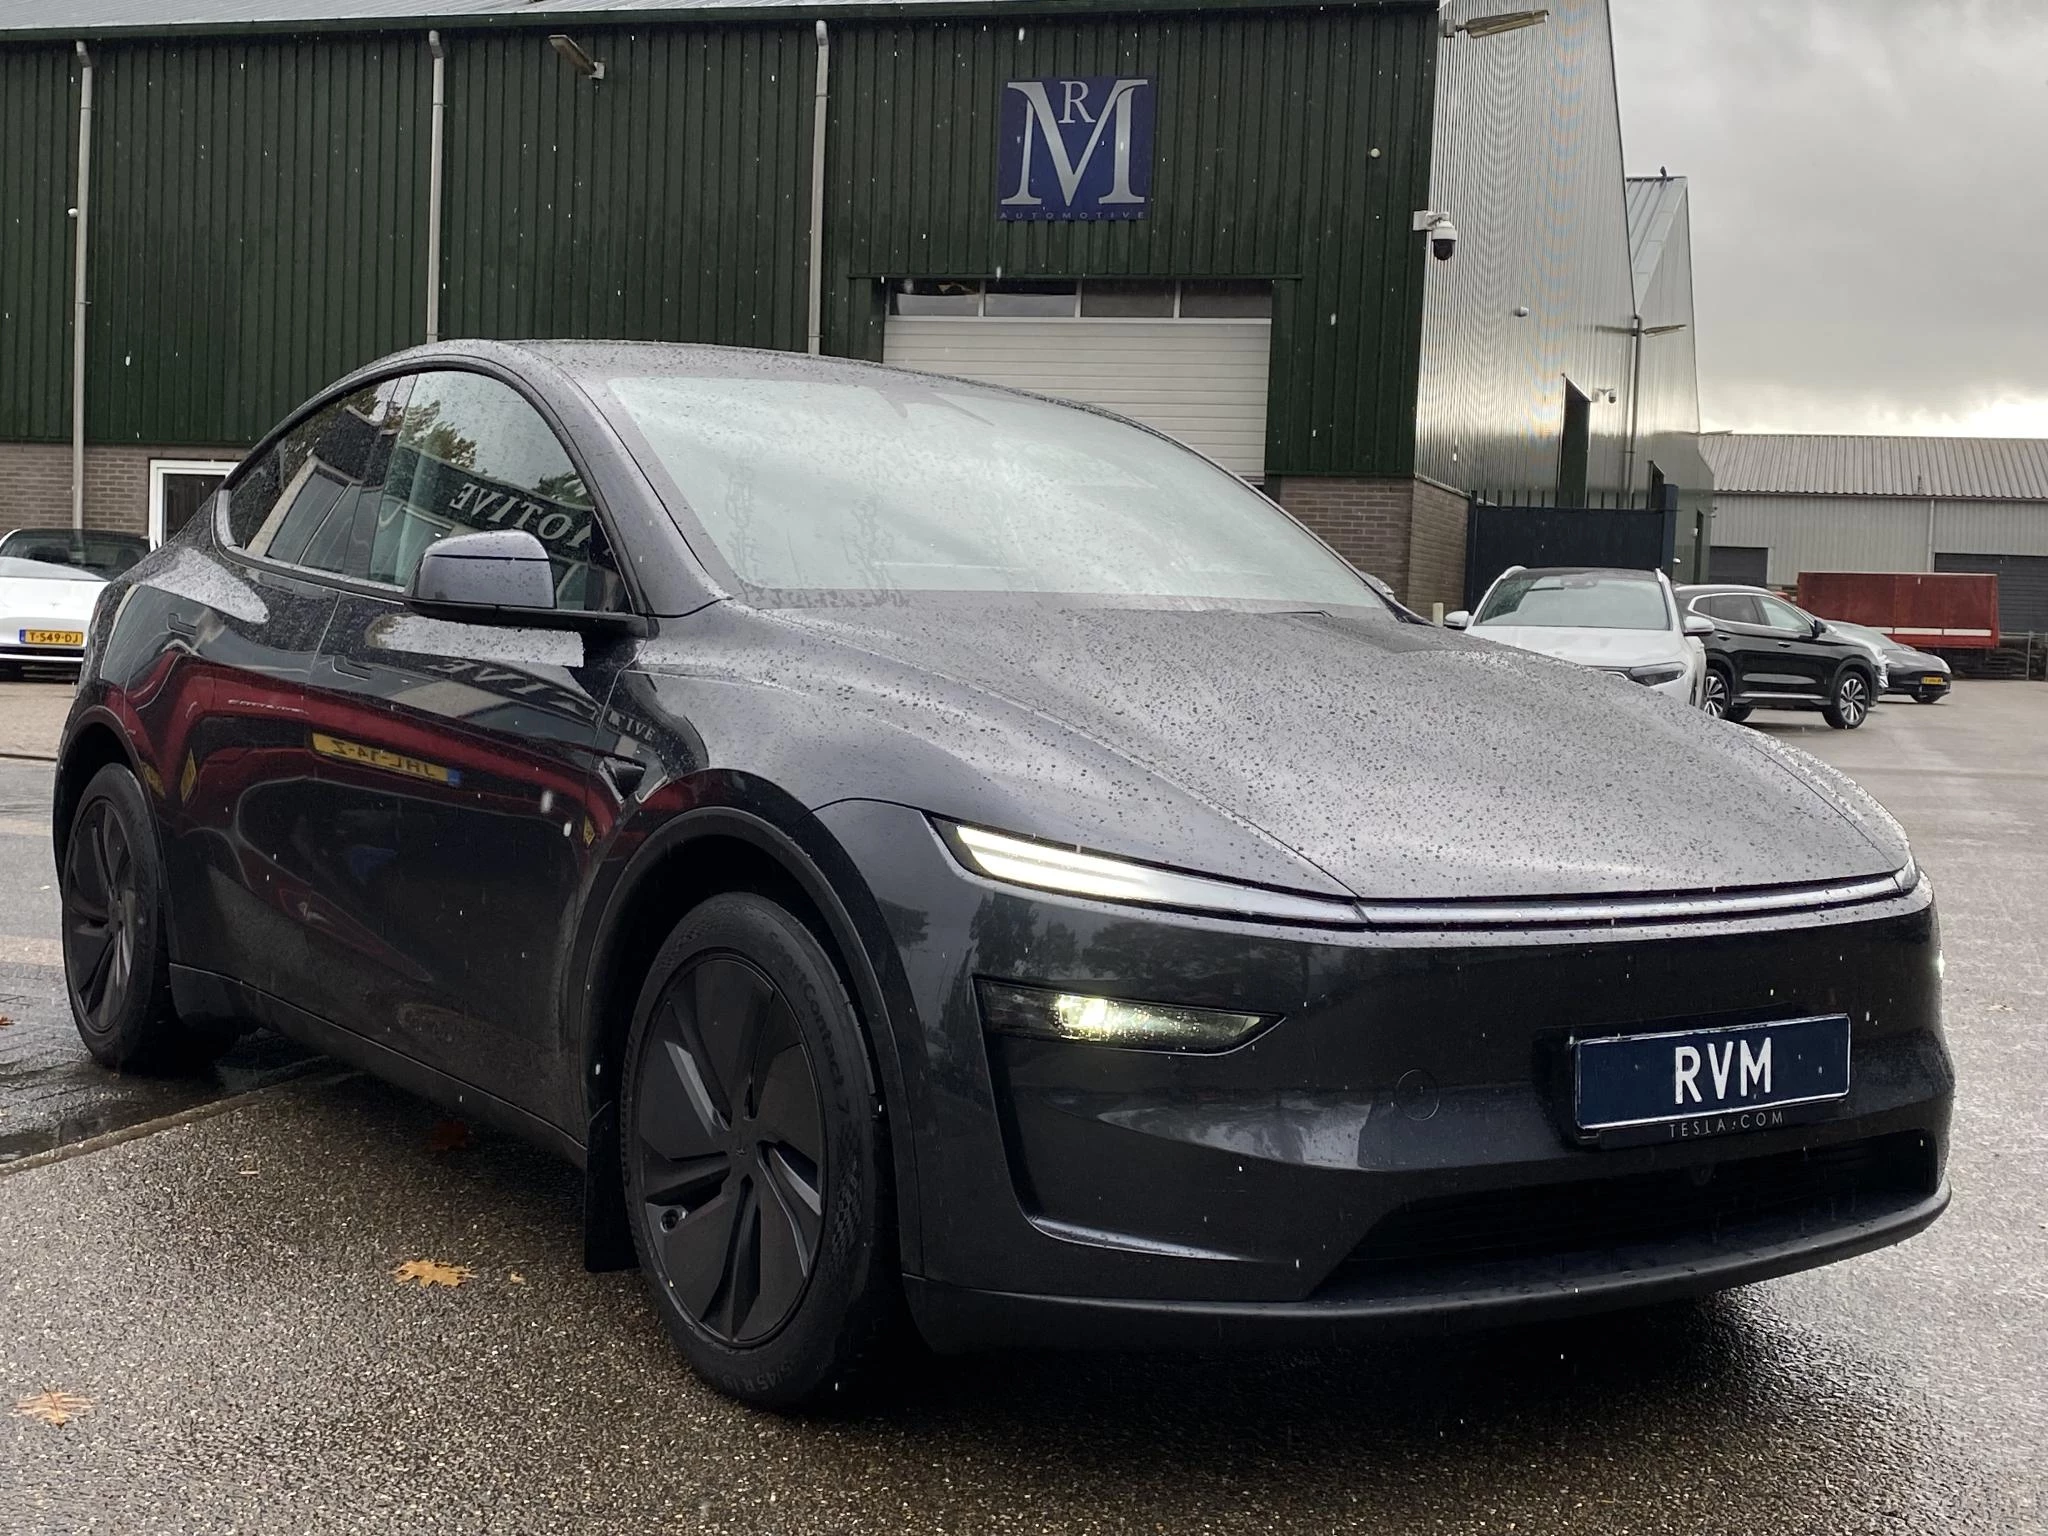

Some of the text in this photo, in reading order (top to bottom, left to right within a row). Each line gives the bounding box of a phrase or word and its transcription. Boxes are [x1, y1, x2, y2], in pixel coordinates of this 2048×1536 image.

[999, 211, 1145, 219] AUTOMOTIVE
[1675, 1037, 1772, 1104] RVM
[1669, 1111, 1784, 1138] TESLA.COM
